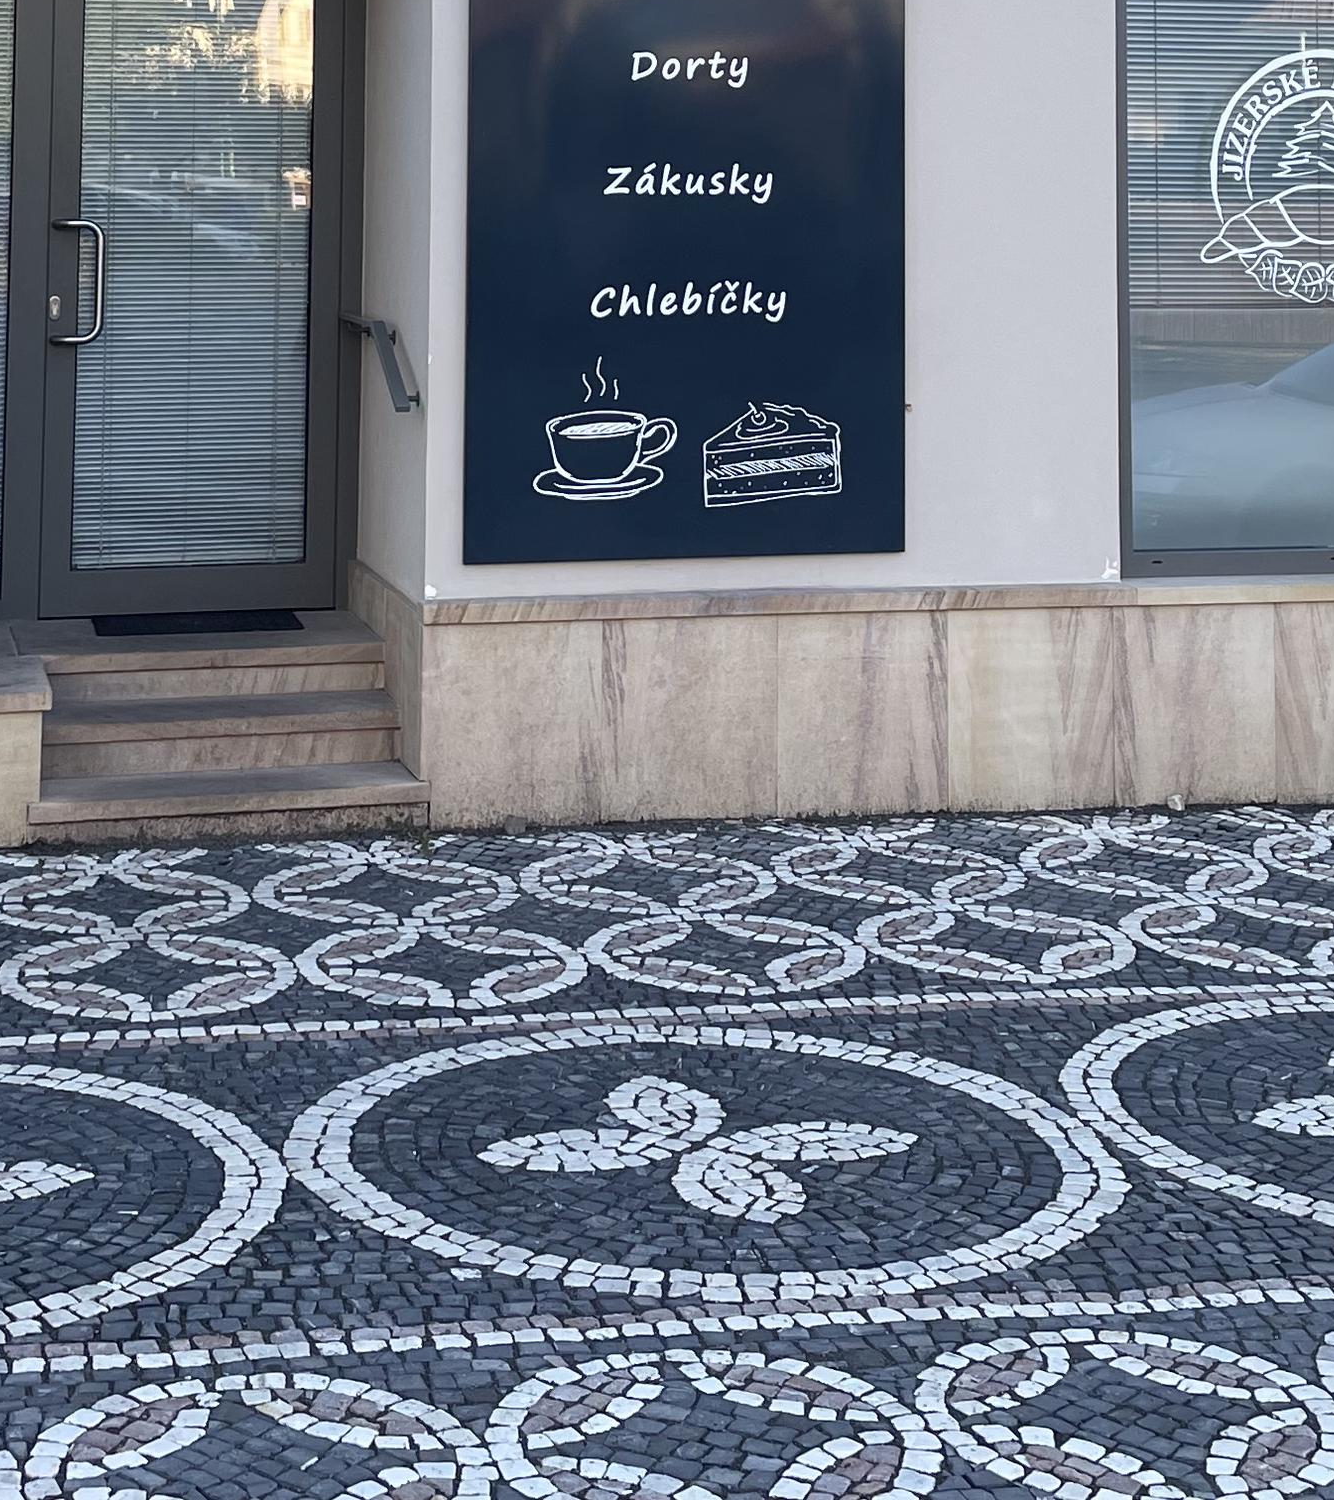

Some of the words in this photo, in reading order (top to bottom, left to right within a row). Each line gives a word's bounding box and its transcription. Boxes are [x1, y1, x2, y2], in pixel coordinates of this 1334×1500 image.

[630, 50, 749, 88] Dorty
[1221, 59, 1322, 182] JIZERSKÉ
[602, 162, 774, 204] Zákusky
[590, 280, 787, 323] Chlebíčky
